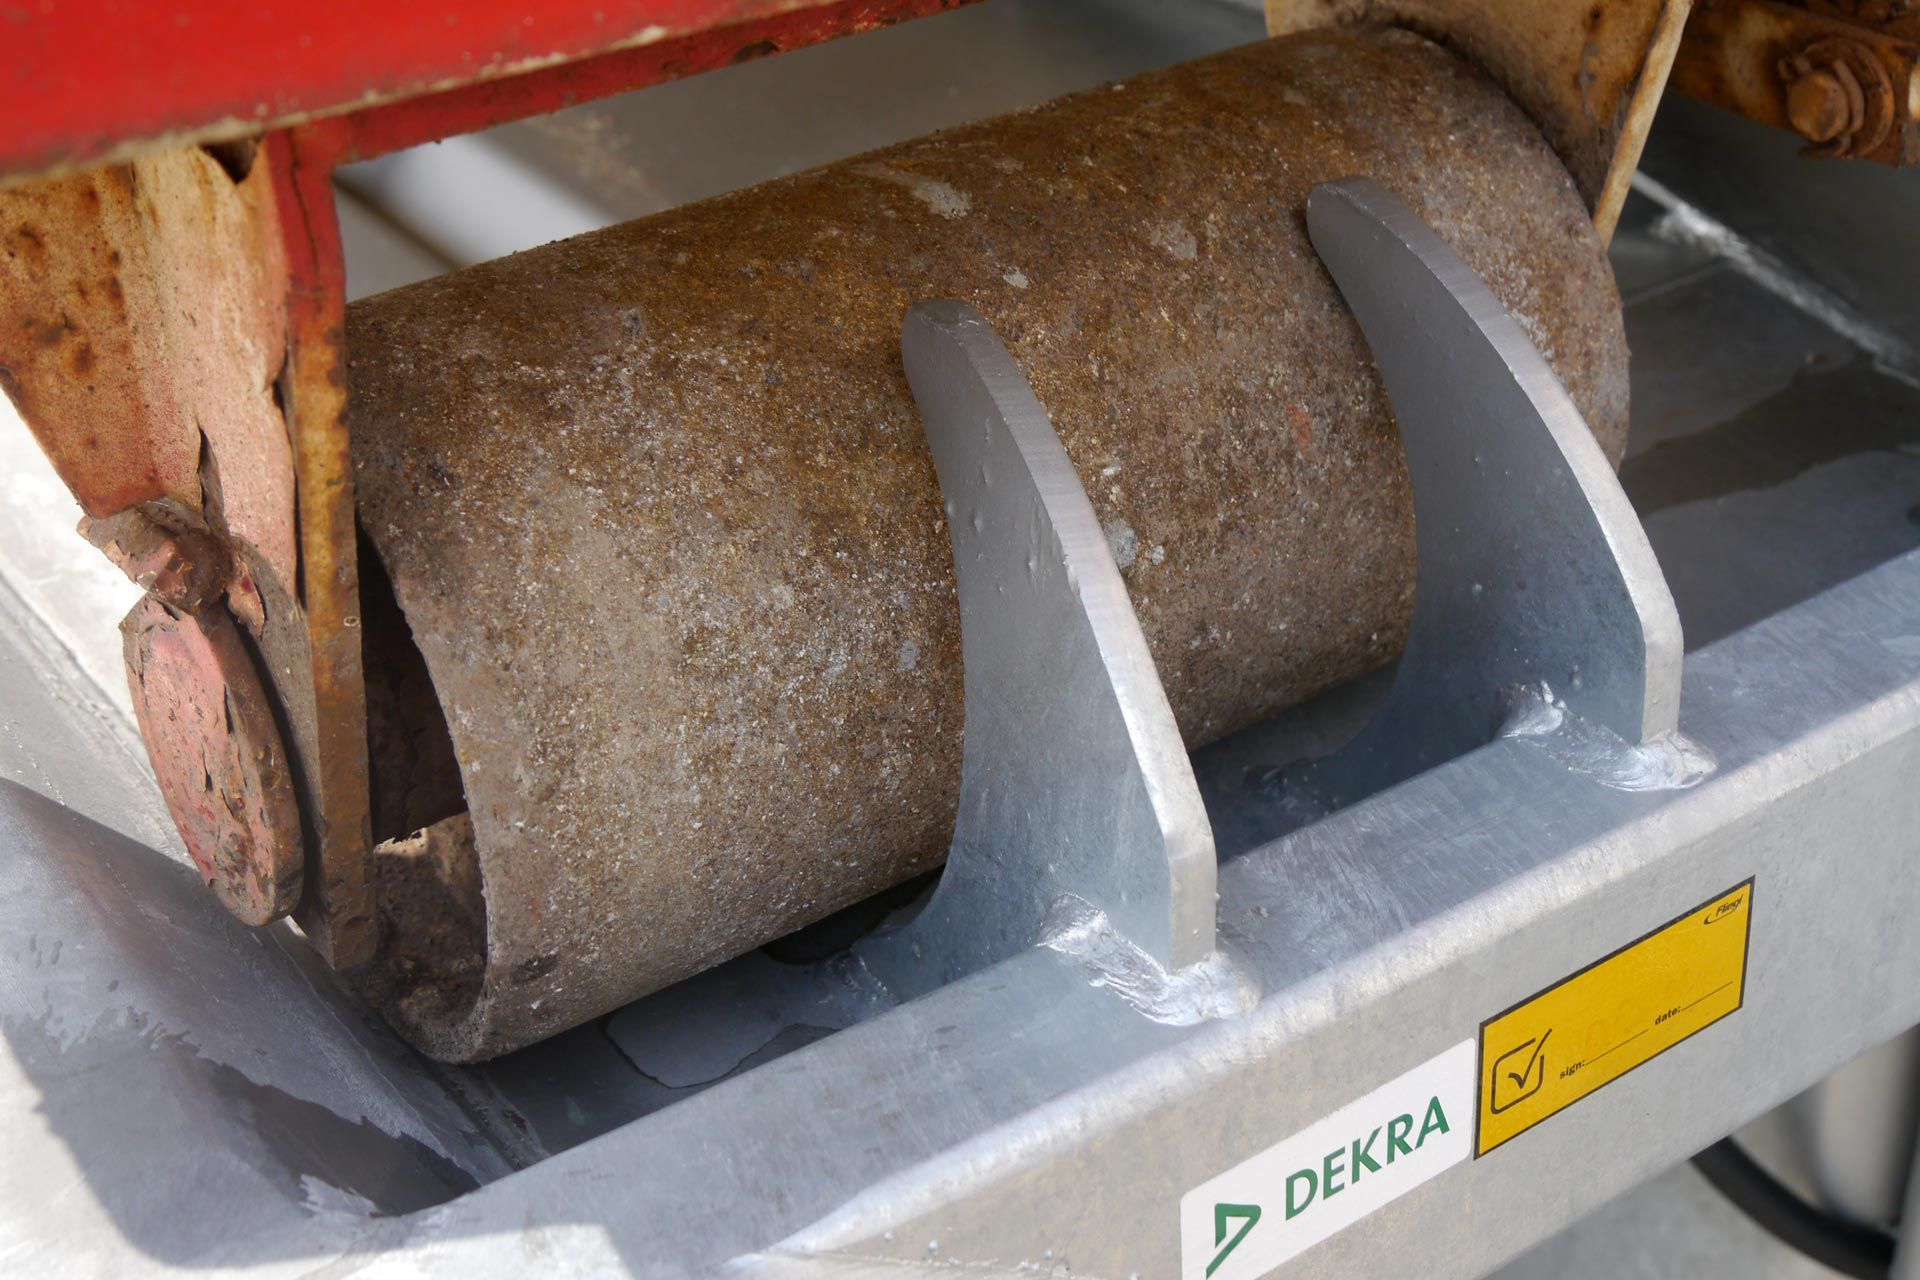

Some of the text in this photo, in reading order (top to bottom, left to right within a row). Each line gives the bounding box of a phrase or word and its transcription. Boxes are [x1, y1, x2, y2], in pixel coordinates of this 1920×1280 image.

[1559, 1005, 1682, 1079] sign: date:
[1285, 1095, 1450, 1221] DEKRA
